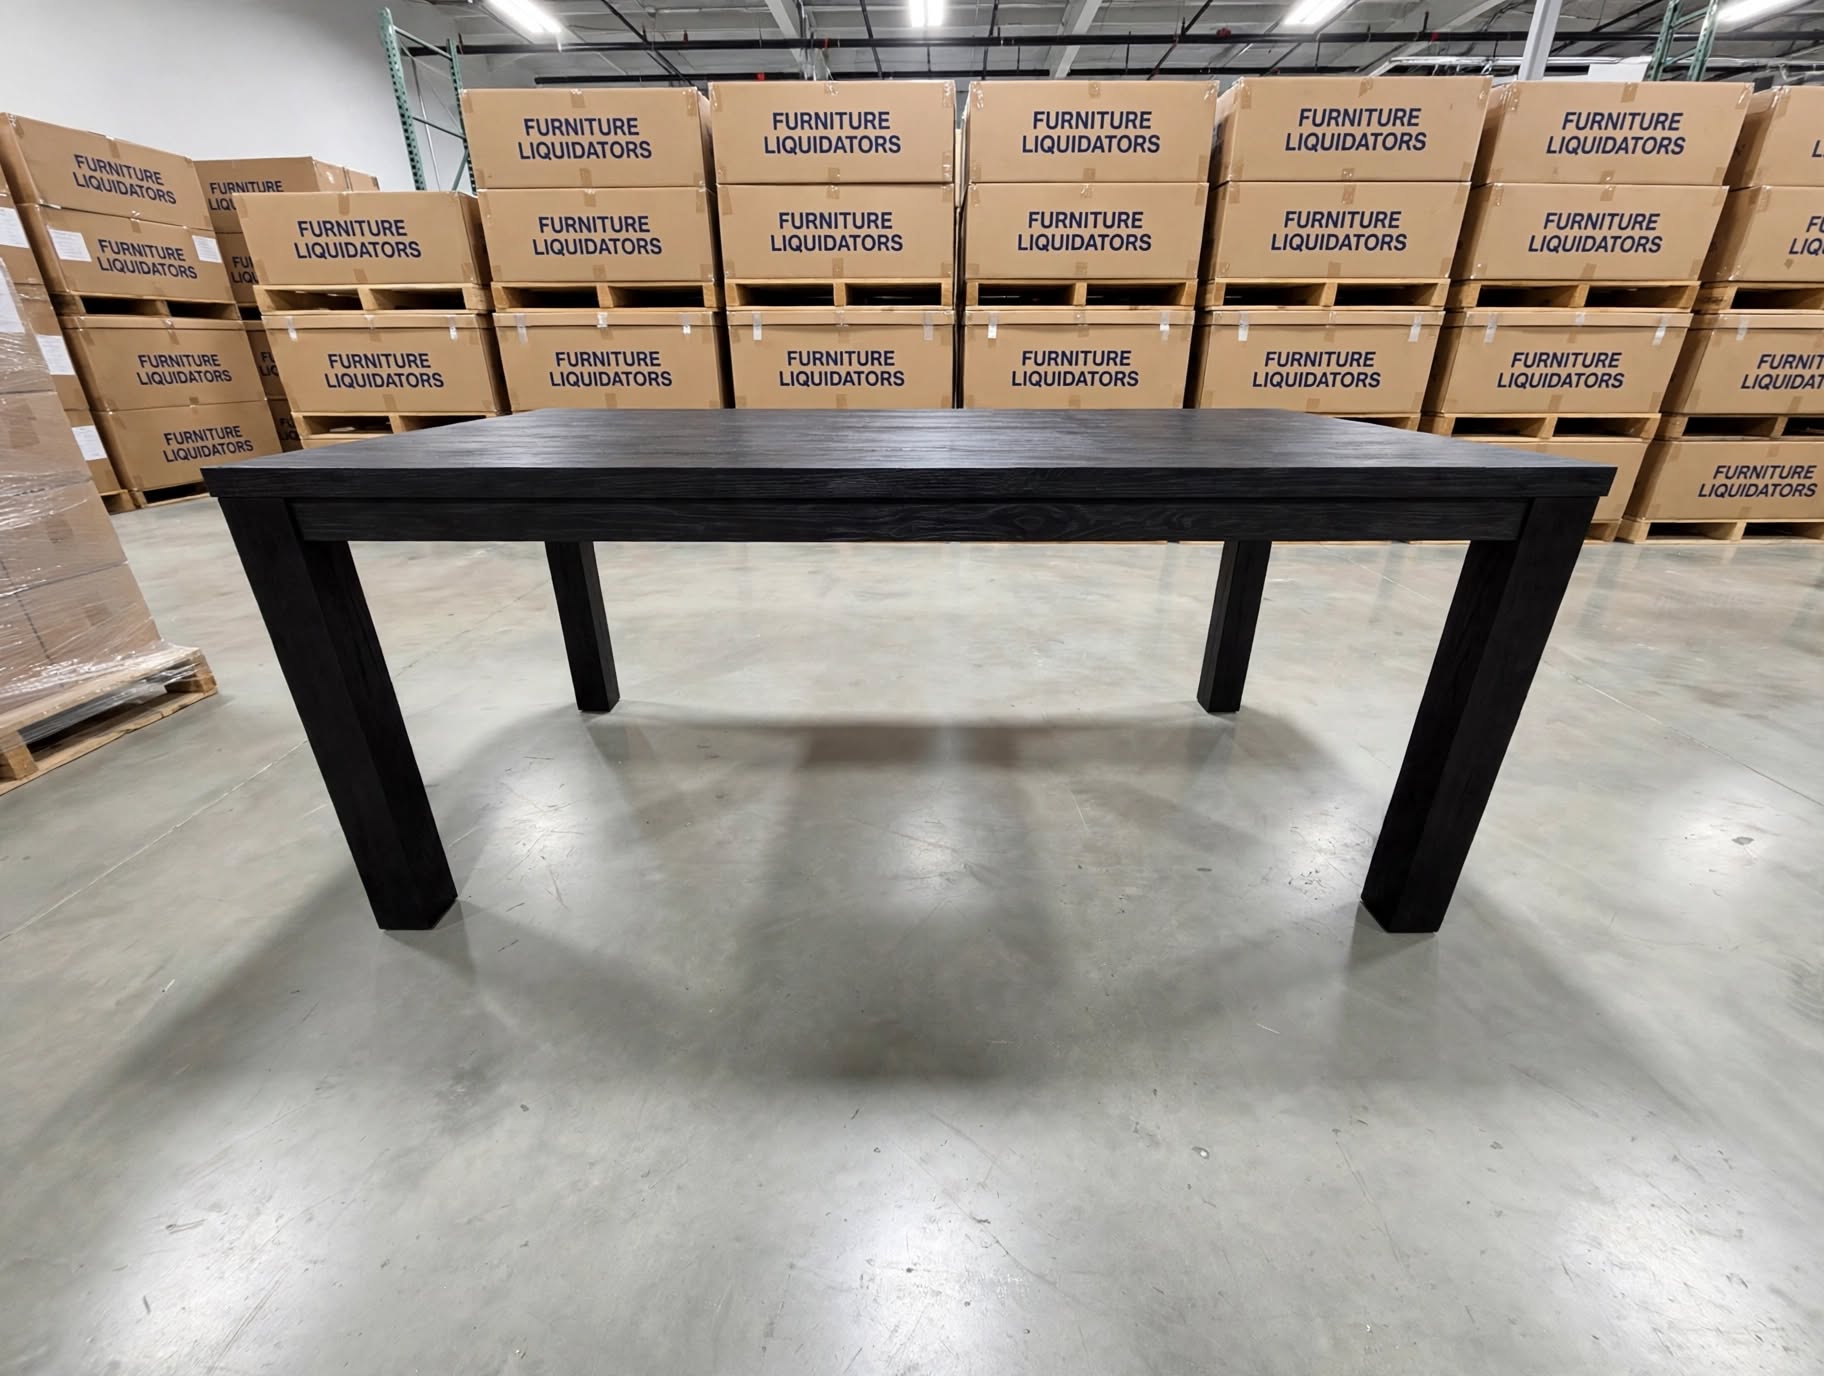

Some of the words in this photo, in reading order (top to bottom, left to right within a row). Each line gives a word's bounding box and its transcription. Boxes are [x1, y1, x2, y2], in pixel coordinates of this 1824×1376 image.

[523, 117, 640, 137] FURNITURE
[772, 111, 891, 131] FURNITURE
[1033, 110, 1153, 130] FURNITURE
[1298, 107, 1422, 128] FURNITURE
[1561, 111, 1684, 131] FURNITURE
[517, 140, 652, 161] LIQUIDATORS
[764, 134, 901, 156] LIQUIDATORS
[1022, 134, 1161, 155] LIQUIDATORS
[1285, 131, 1427, 153] LIQUIDATORS
[1545, 135, 1686, 156] LIQUIDATORS
[73, 153, 165, 186] FURNITURE
[72, 171, 177, 205] LIQUIDATORS
[209, 180, 284, 194] FURNITURE
[297, 219, 408, 238] FURNITURE
[538, 215, 651, 234] FURNITURE
[778, 211, 893, 230] FURNITURE
[1028, 211, 1144, 229] FURNITURE
[1284, 210, 1402, 229] FURNITURE
[1543, 212, 1661, 231] FURNITURE
[97, 238, 186, 262] FURNITURE
[294, 240, 422, 260] LIQUIDATORS
[532, 237, 663, 257] LIQUIDATORS
[770, 233, 904, 253] LIQUIDATORS
[1017, 233, 1152, 252] LIQUIDATORS
[1270, 233, 1408, 252] LIQUIDATORS
[1527, 234, 1663, 254] LIQUIDATORS
[96, 256, 198, 280] LIQUIDATORS
[137, 353, 221, 369] FURNITURE
[327, 352, 432, 370] FURNITURE
[555, 350, 662, 368] FURNITURE
[787, 350, 895, 367] FURNITURE
[1021, 350, 1132, 367] FURNITURE
[1264, 351, 1377, 368] FURNITURE
[1510, 351, 1623, 369] FURNITURE
[136, 369, 233, 386] LIQUIDATORS
[324, 372, 445, 389] LIQUIDATORS
[549, 370, 673, 388] LIQUIDATORS
[779, 370, 905, 388] LIQUIDATORS
[1011, 370, 1139, 388] LIQUIDATORS
[1252, 371, 1381, 389] LIQUIDATORS
[1497, 372, 1625, 390] LIQUIDATORS
[163, 425, 243, 446] FURNITURE
[162, 439, 254, 463] LIQUIDATORS
[1712, 464, 1817, 480] FURNITURE
[1697, 482, 1818, 499] LIQUIDATORS
